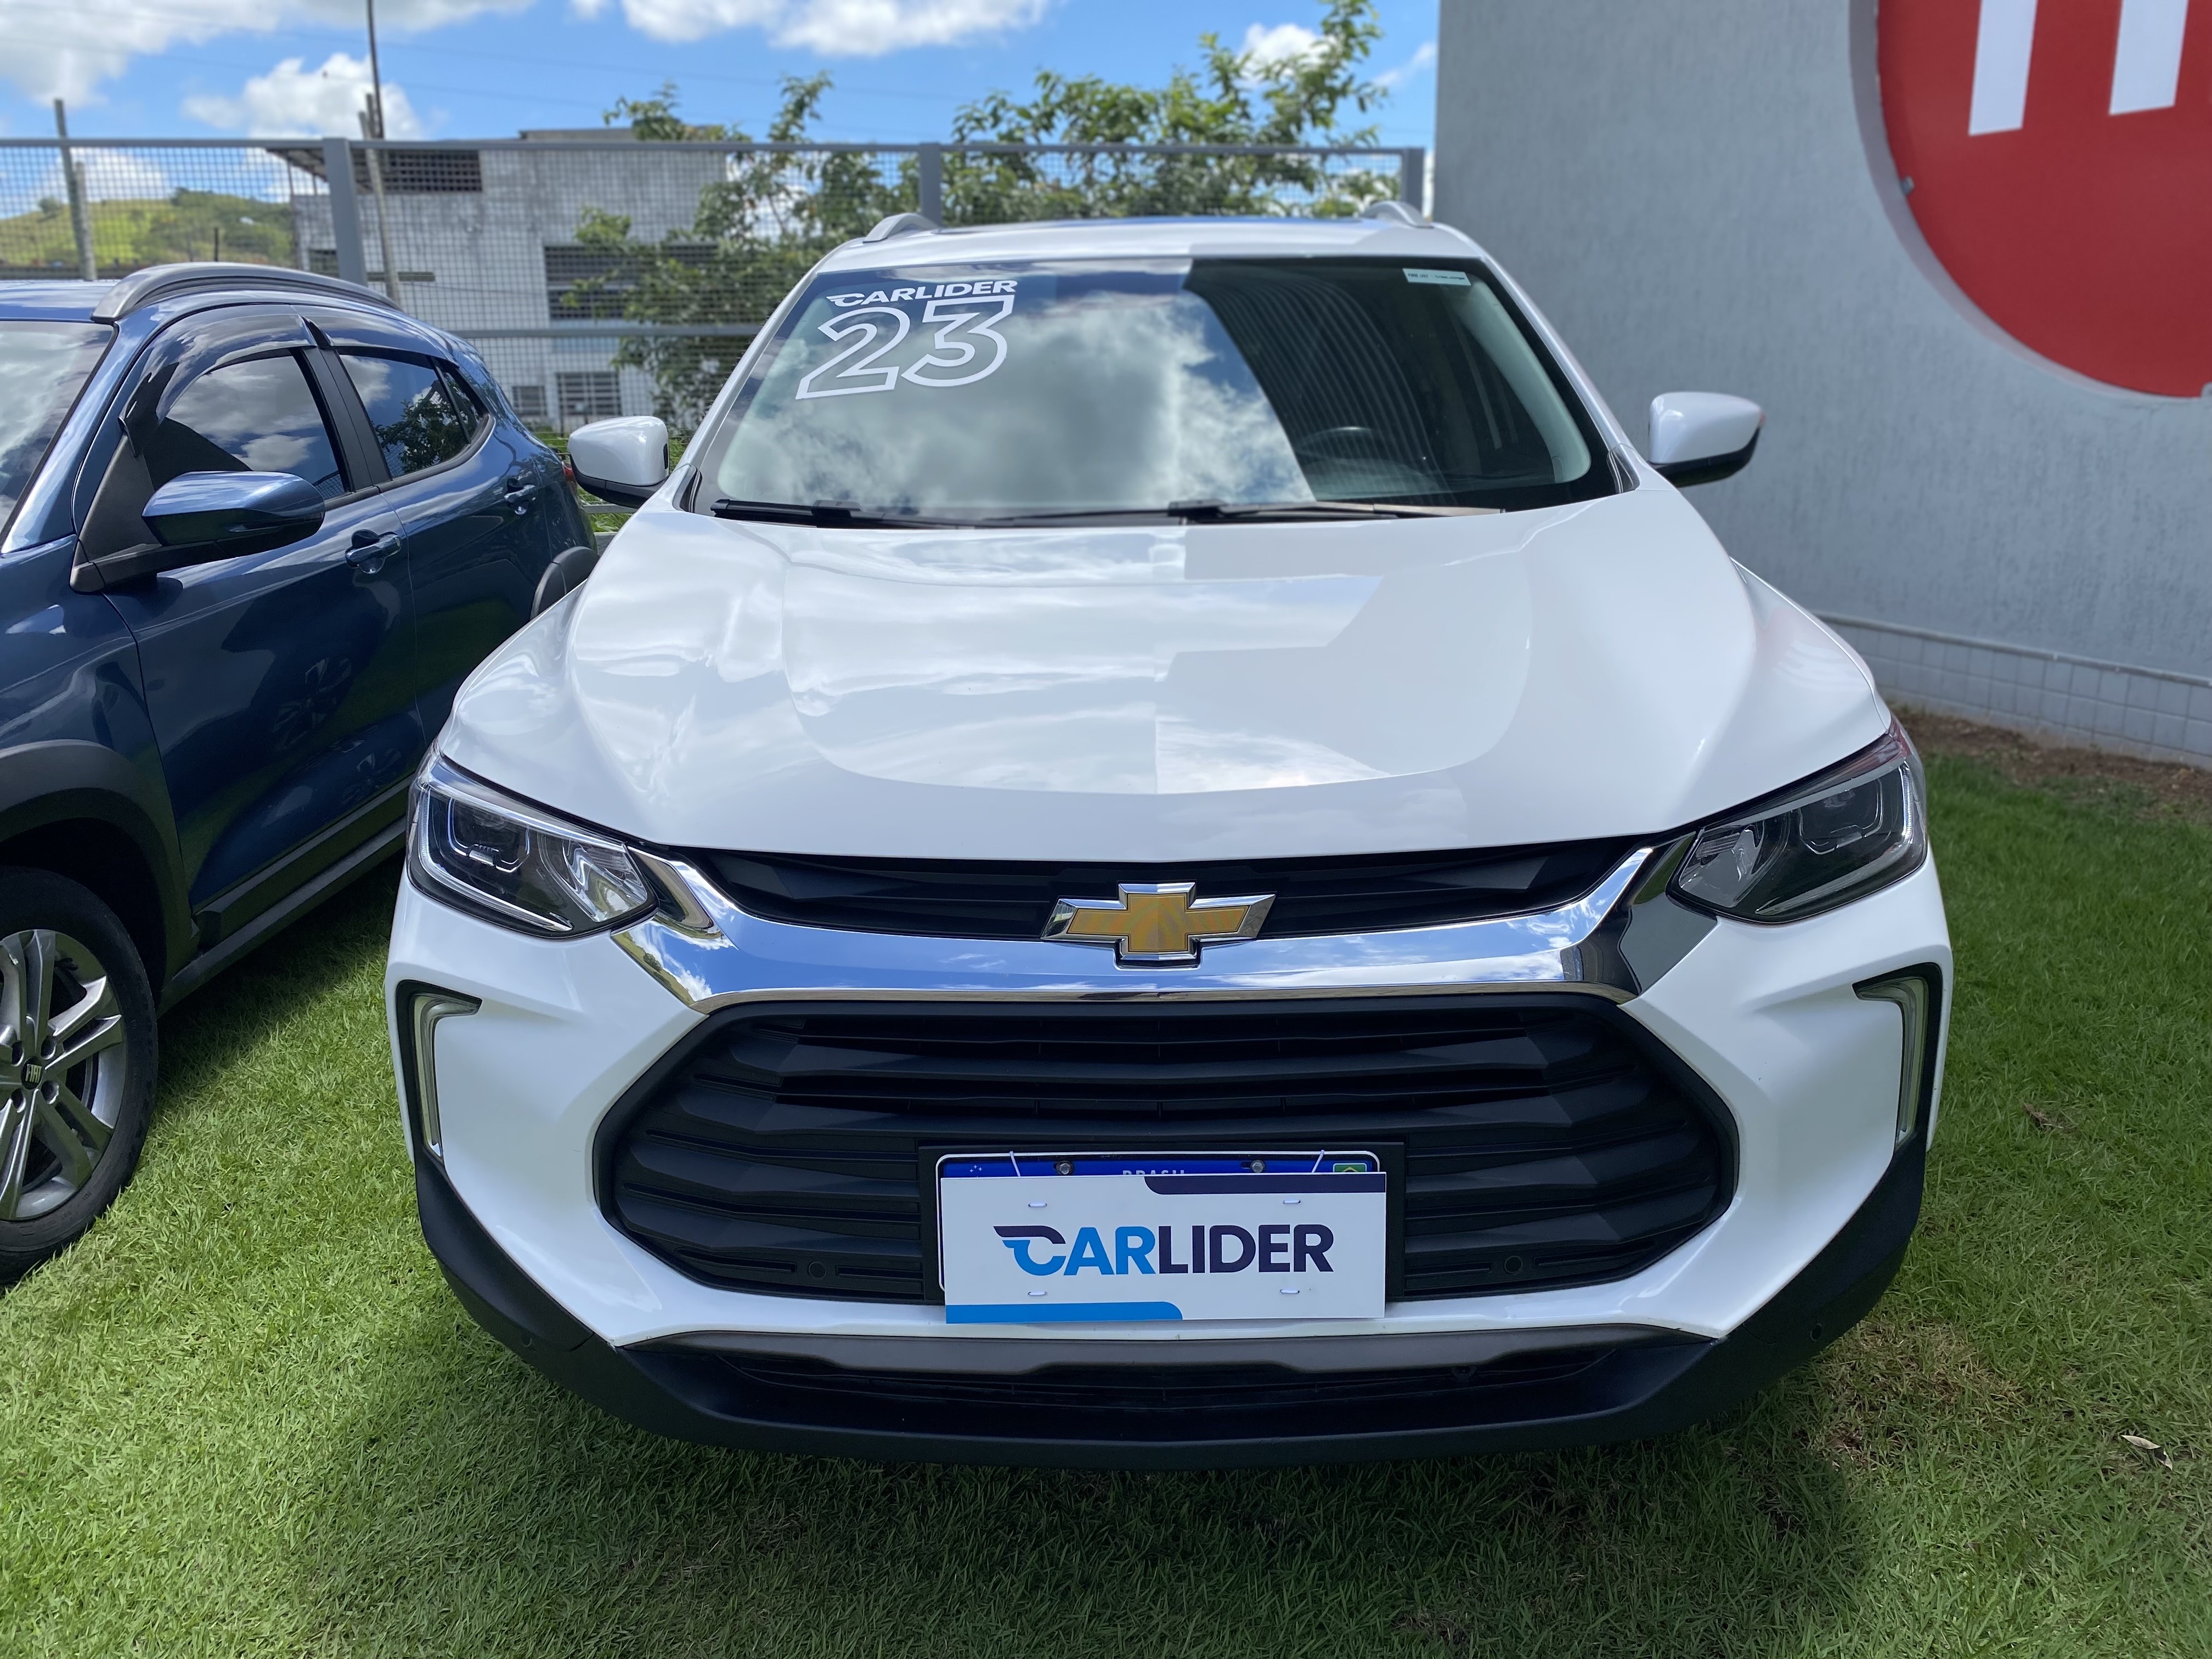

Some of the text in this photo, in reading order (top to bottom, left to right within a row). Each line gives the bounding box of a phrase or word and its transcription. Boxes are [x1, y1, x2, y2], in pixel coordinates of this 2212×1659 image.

[826, 280, 1018, 307] CARLIDER
[795, 295, 1015, 400] 23
[25, 1063, 42, 1084] FIAT
[994, 1224, 1334, 1277] CARLIDER
